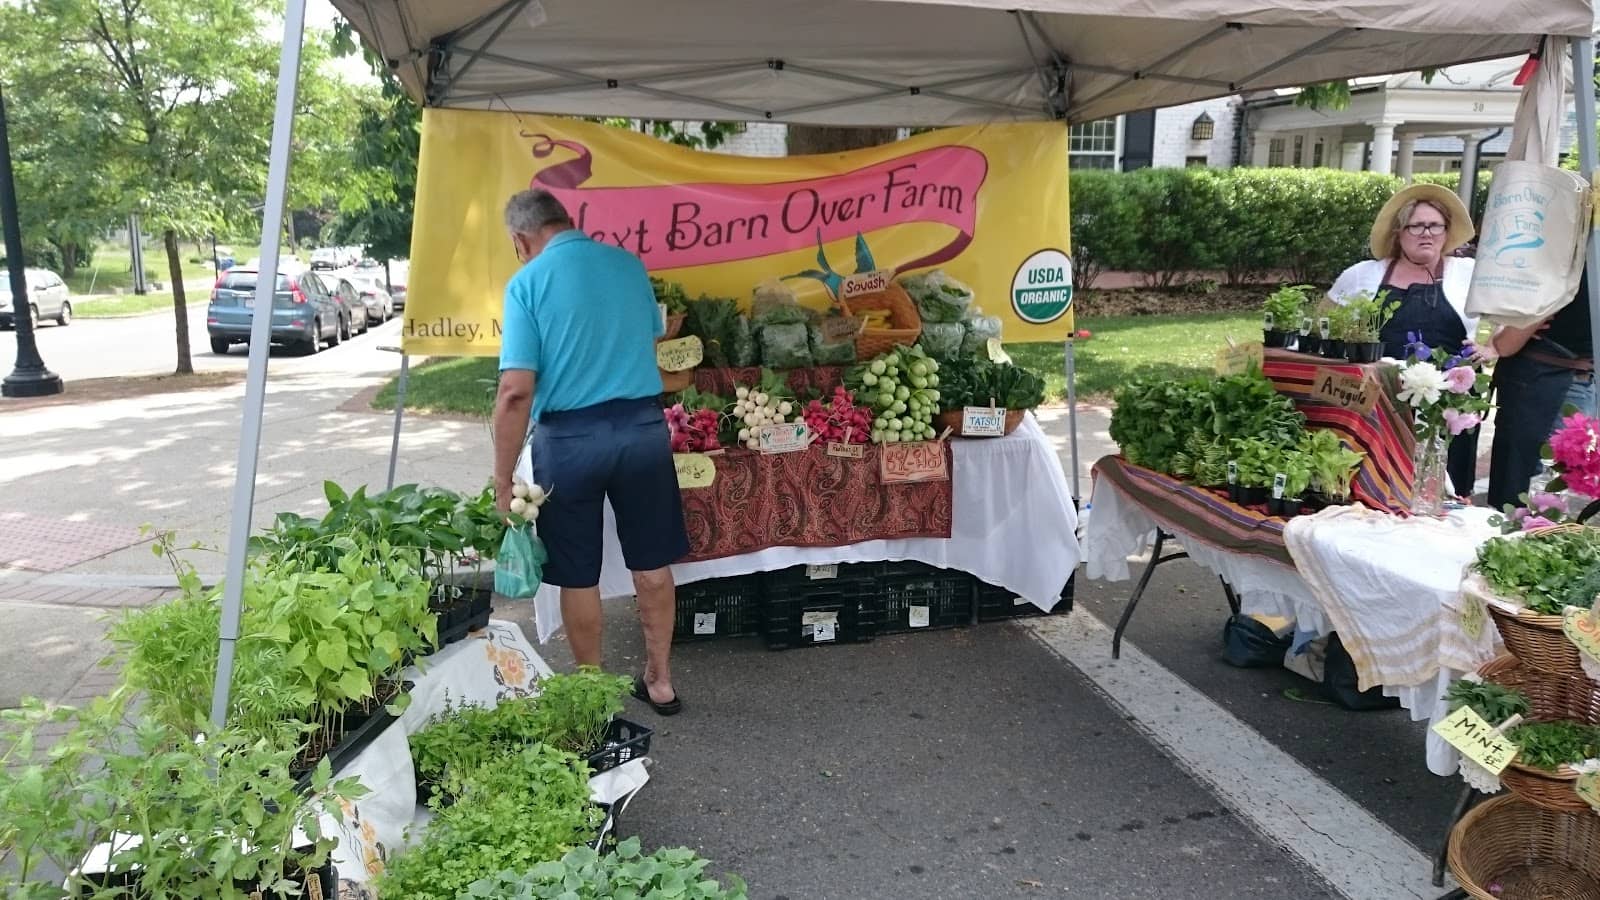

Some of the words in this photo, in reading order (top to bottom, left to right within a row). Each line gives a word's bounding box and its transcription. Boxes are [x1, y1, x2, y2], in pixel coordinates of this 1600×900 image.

[665, 201, 769, 251] Barn
[781, 188, 875, 234] Over
[883, 163, 963, 214] Farm
[1028, 267, 1064, 285] USDA
[1021, 289, 1067, 305] ORGANIC
[402, 317, 484, 342] Hadley,
[1320, 376, 1366, 406] Arugula
[969, 416, 1000, 426] TATSOI
[1454, 717, 1504, 754] Mint
